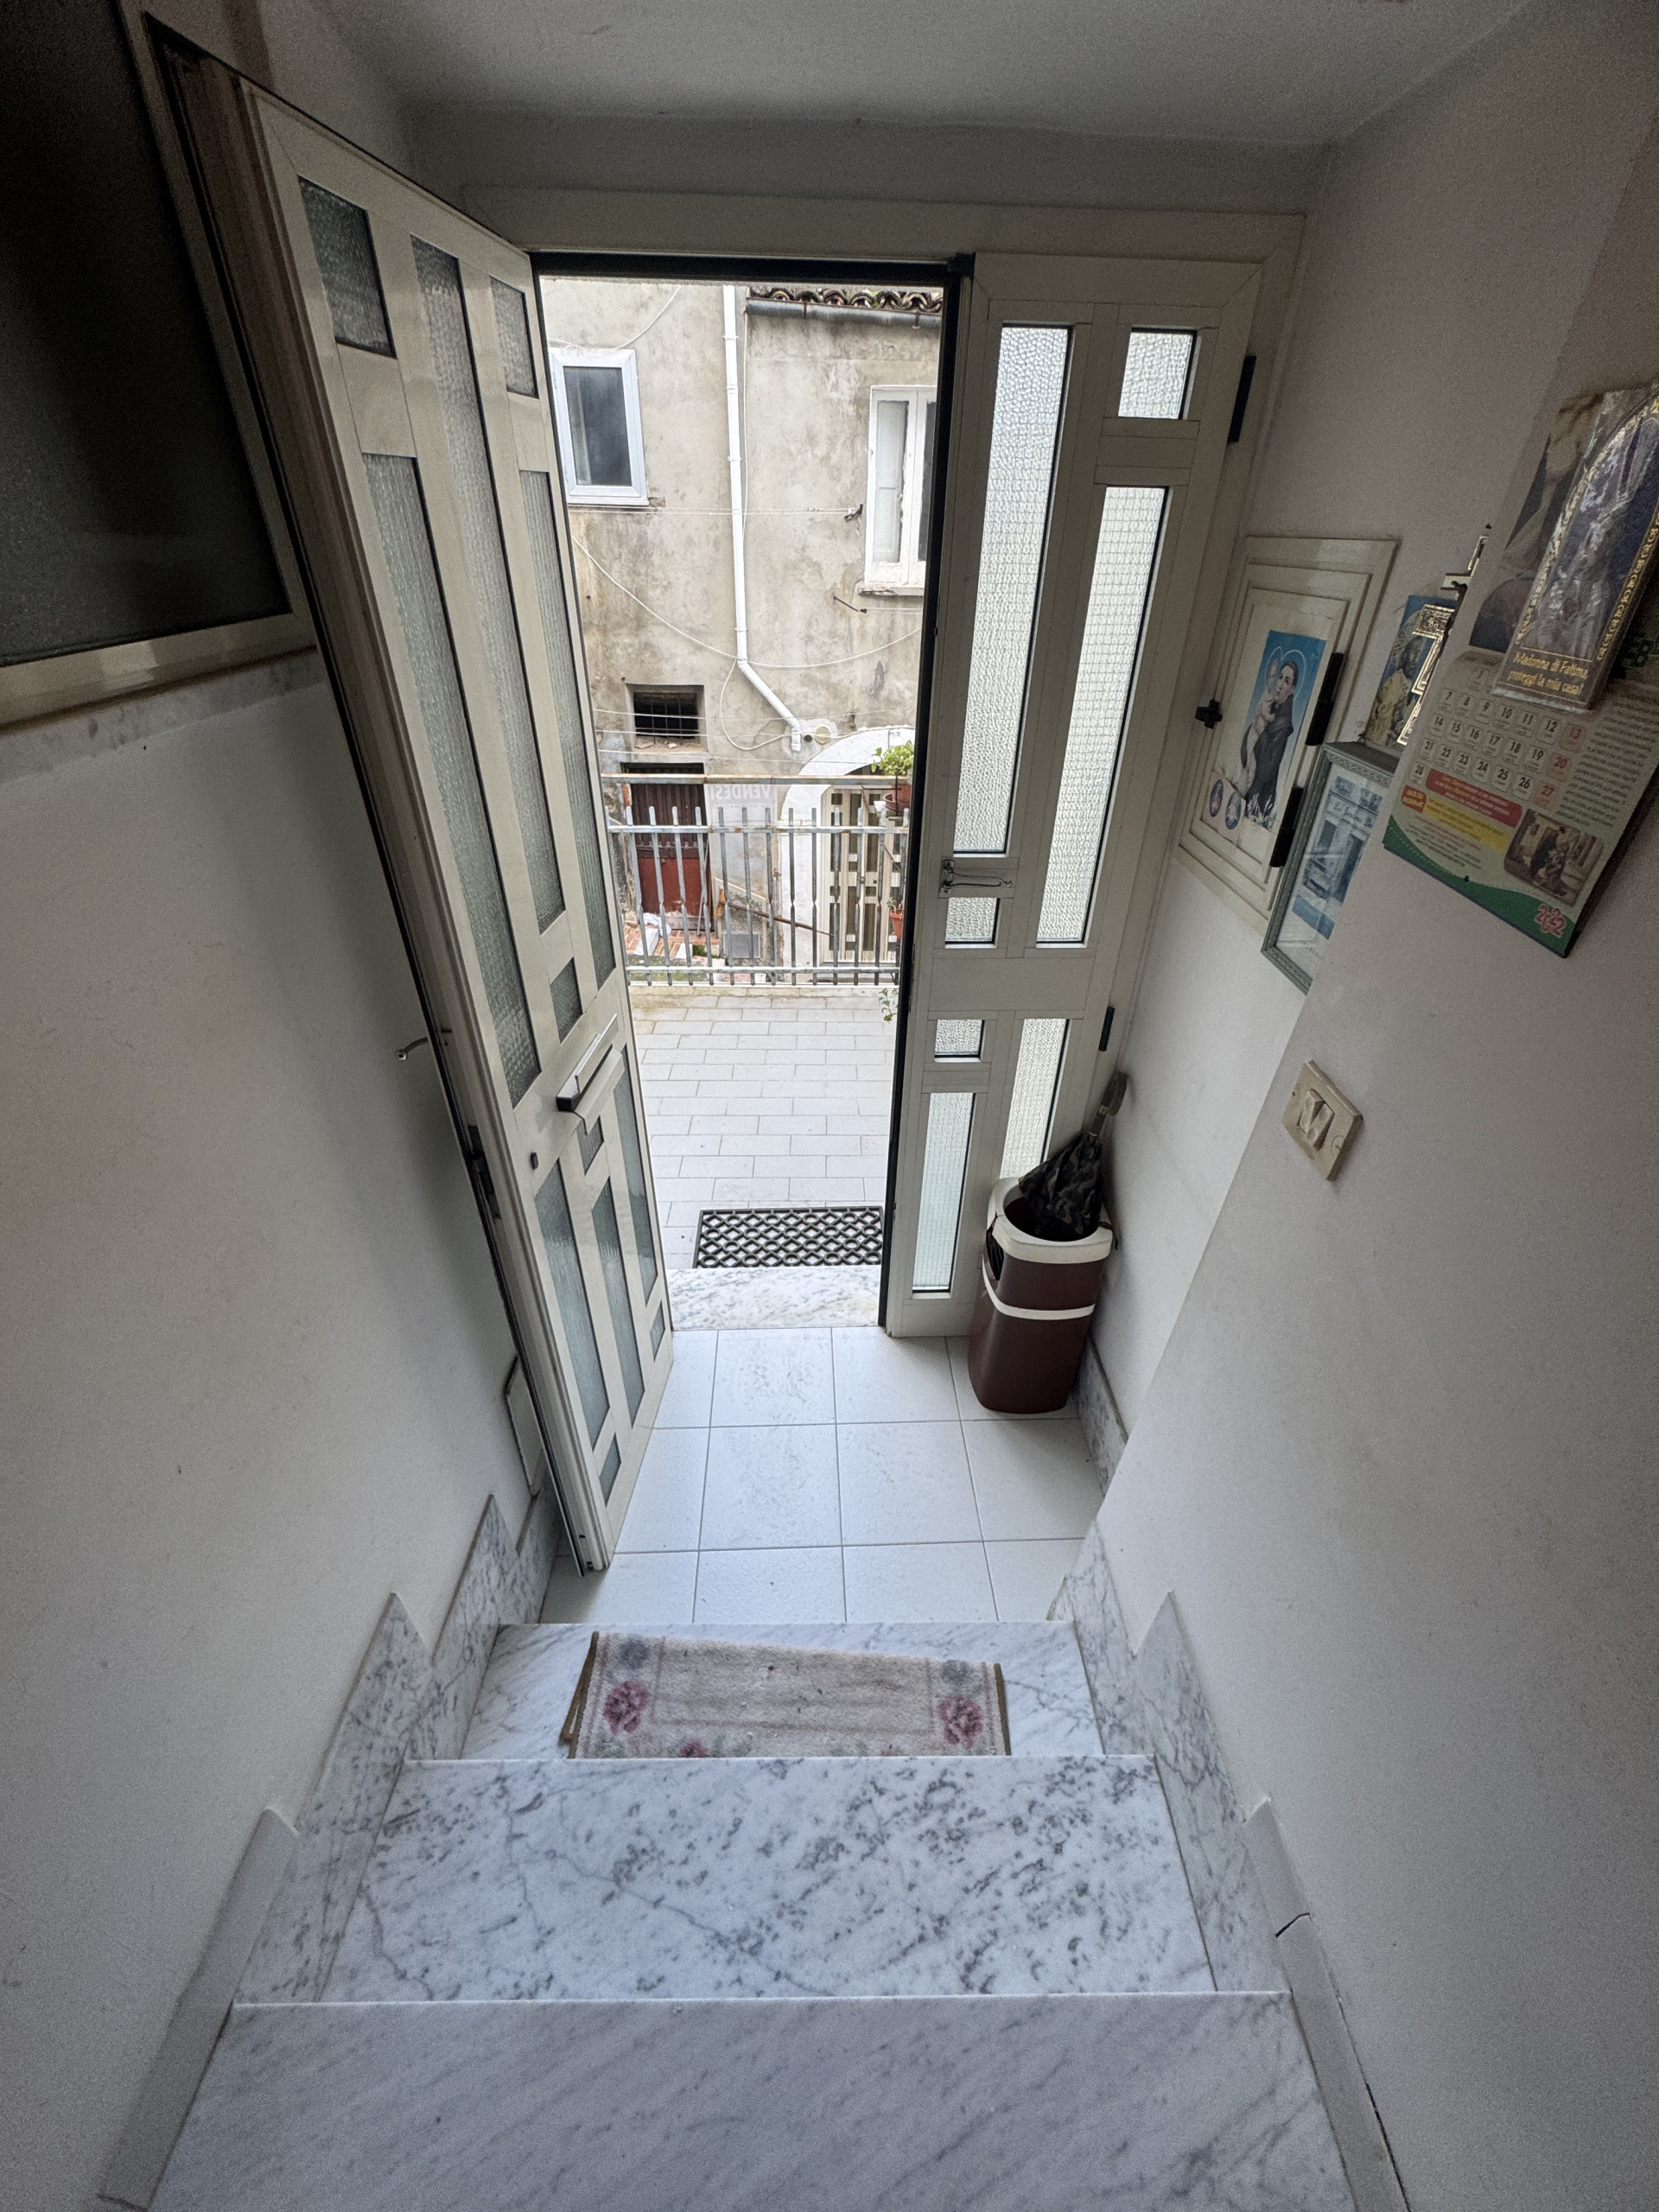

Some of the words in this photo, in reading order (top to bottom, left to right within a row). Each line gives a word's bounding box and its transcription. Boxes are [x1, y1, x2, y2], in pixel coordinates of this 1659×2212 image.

[1513, 652, 1550, 670] Madonna
[1550, 658, 1560, 672] di
[1536, 673, 1545, 687] la
[1445, 690, 1453, 701] 7
[1463, 696, 1471, 706] 8
[1483, 702, 1491, 712] 9
[1501, 707, 1513, 719] 10
[1522, 713, 1534, 725] 11
[1544, 720, 1558, 733] 12
[1569, 727, 1583, 740] 13
[1434, 716, 1444, 727] 14
[1452, 722, 1461, 733] 15
[1470, 728, 1480, 740] 16
[1489, 734, 1501, 746] 17
[1509, 741, 1522, 753] 18
[1532, 749, 1544, 760] 19
[1553, 756, 1567, 769] 20
[1414, 764, 1424, 776] 28
[1424, 741, 1434, 752] 21
[1440, 747, 1452, 758] 22
[1459, 753, 1469, 766] 23
[1477, 760, 1489, 772] 24
[1497, 768, 1510, 780] 25
[1518, 777, 1531, 789] 26
[1541, 785, 1555, 798] 27
